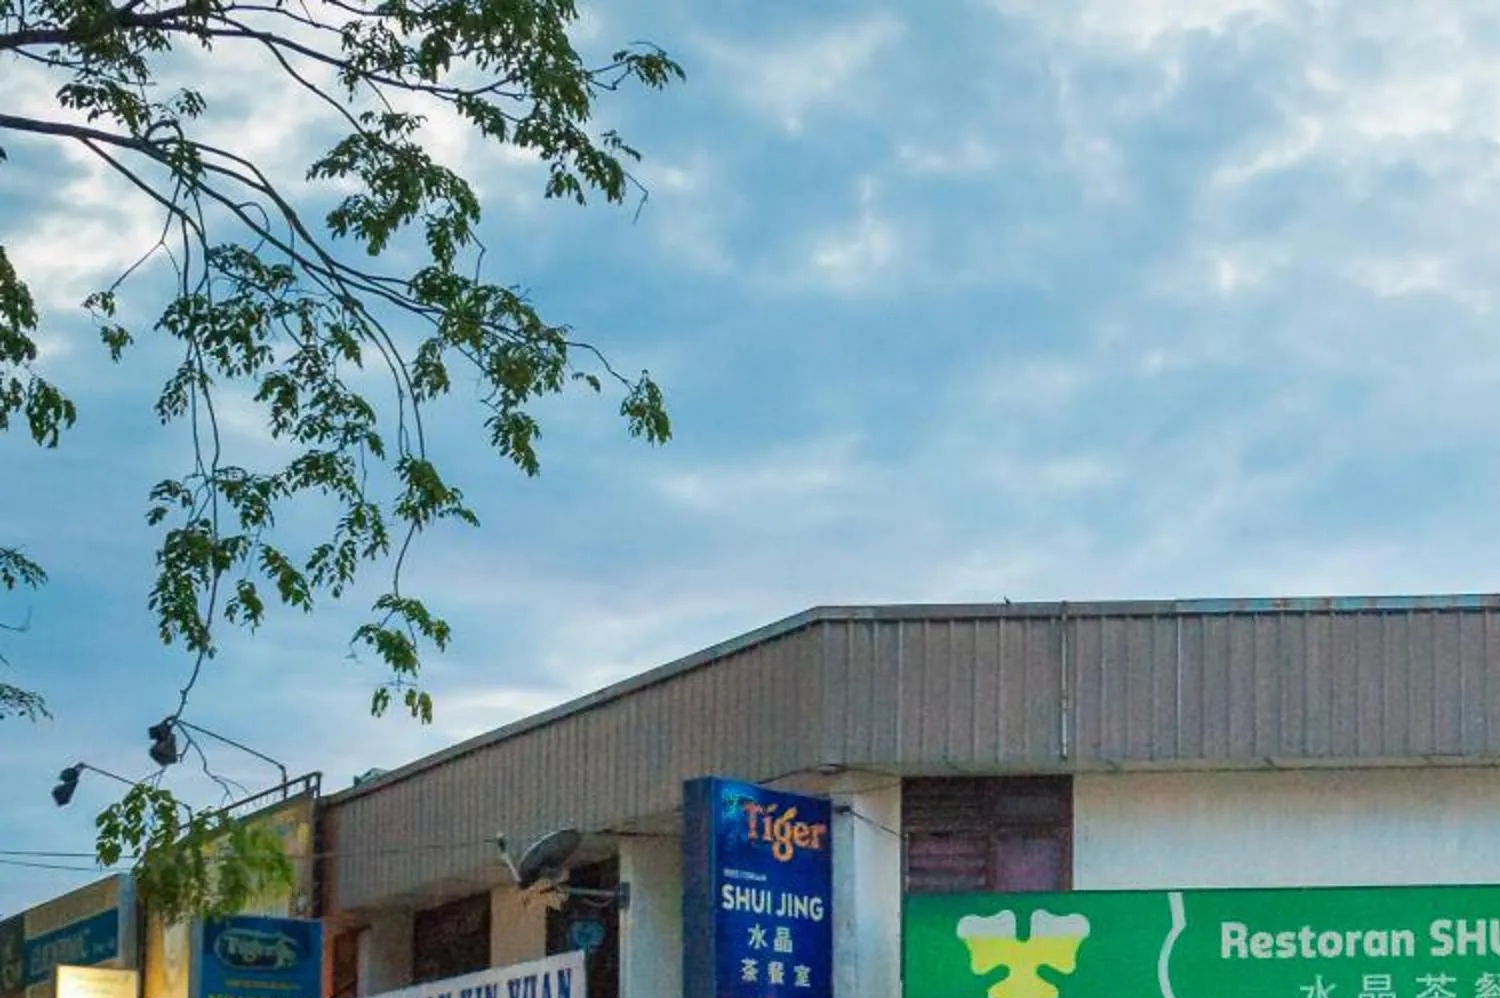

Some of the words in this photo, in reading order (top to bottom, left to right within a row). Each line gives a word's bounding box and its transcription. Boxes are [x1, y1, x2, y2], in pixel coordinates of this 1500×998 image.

[745, 801, 827, 862] Tiger
[721, 884, 772, 915] SHUI
[776, 894, 824, 922] JING
[748, 923, 793, 953] 水晶
[1220, 921, 1416, 960] Restoran
[741, 957, 812, 988] 茶餐室
